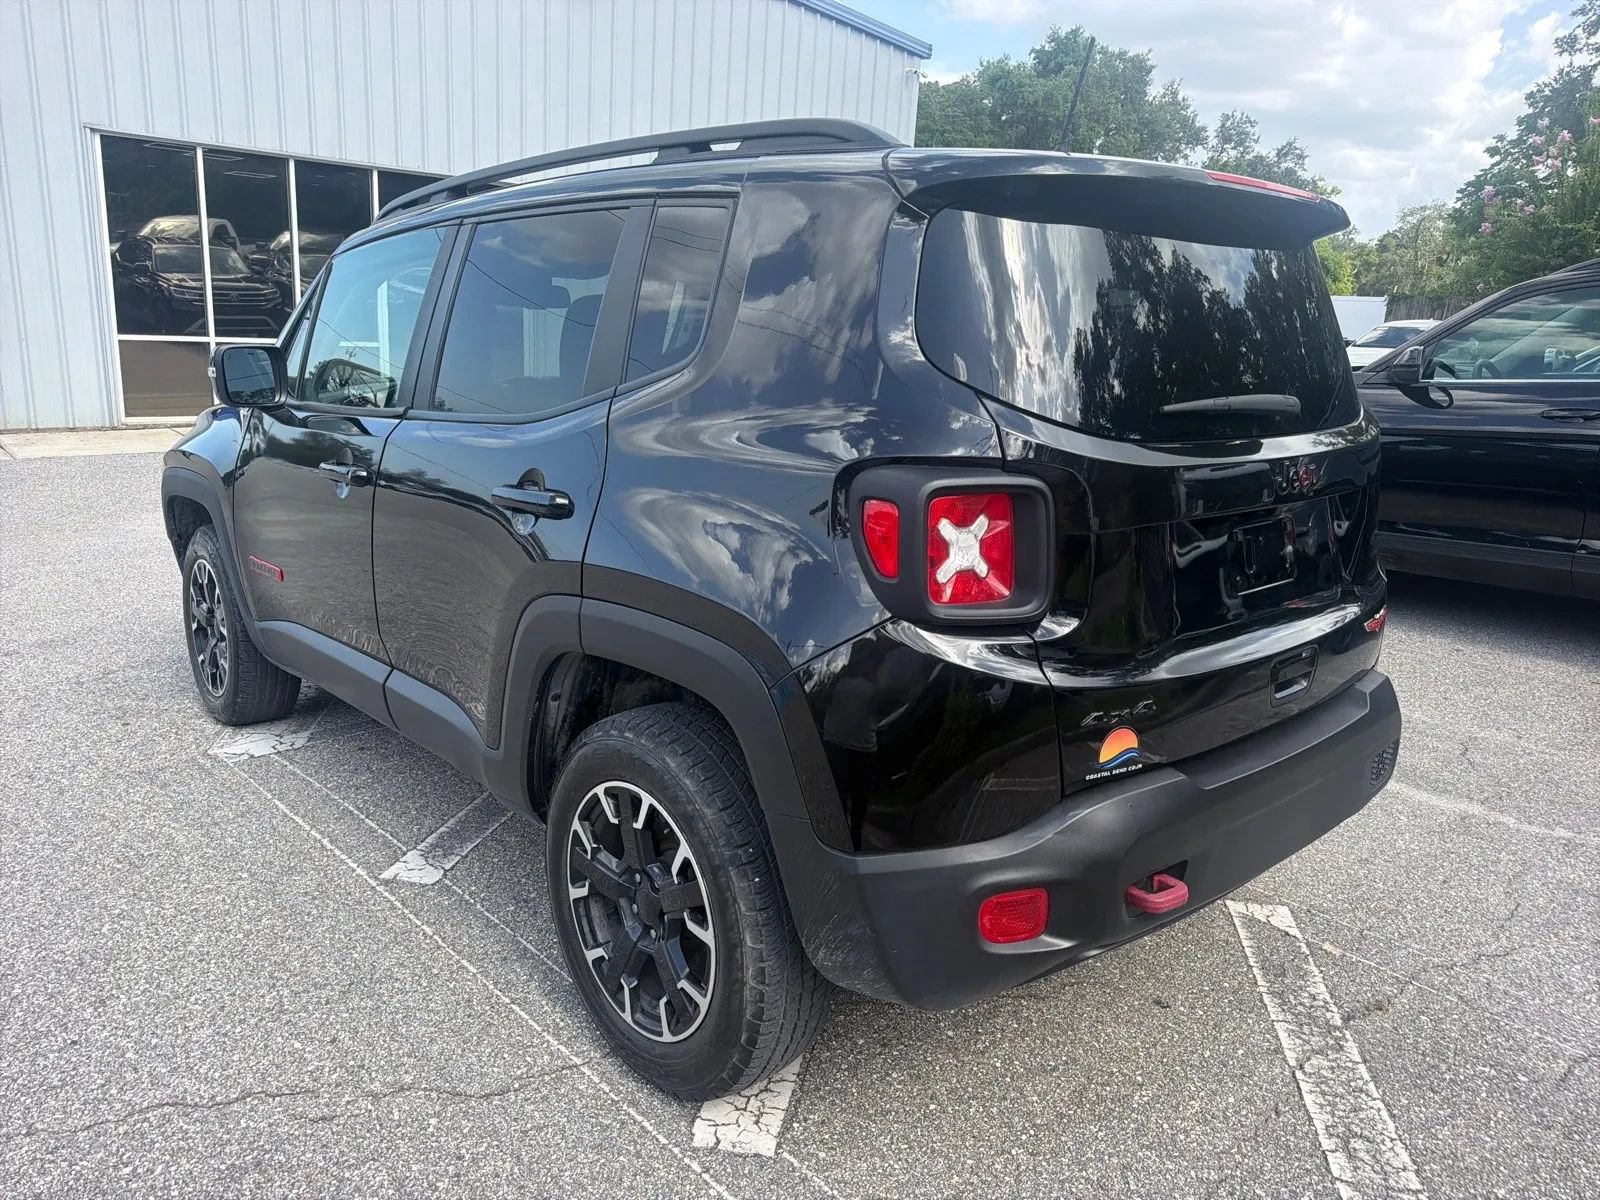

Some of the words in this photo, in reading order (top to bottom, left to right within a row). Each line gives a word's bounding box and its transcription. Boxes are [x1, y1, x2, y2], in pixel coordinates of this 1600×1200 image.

[1274, 459, 1318, 496] Jeep
[1085, 771, 1111, 780] COASTAL
[1112, 767, 1127, 775] BEND
